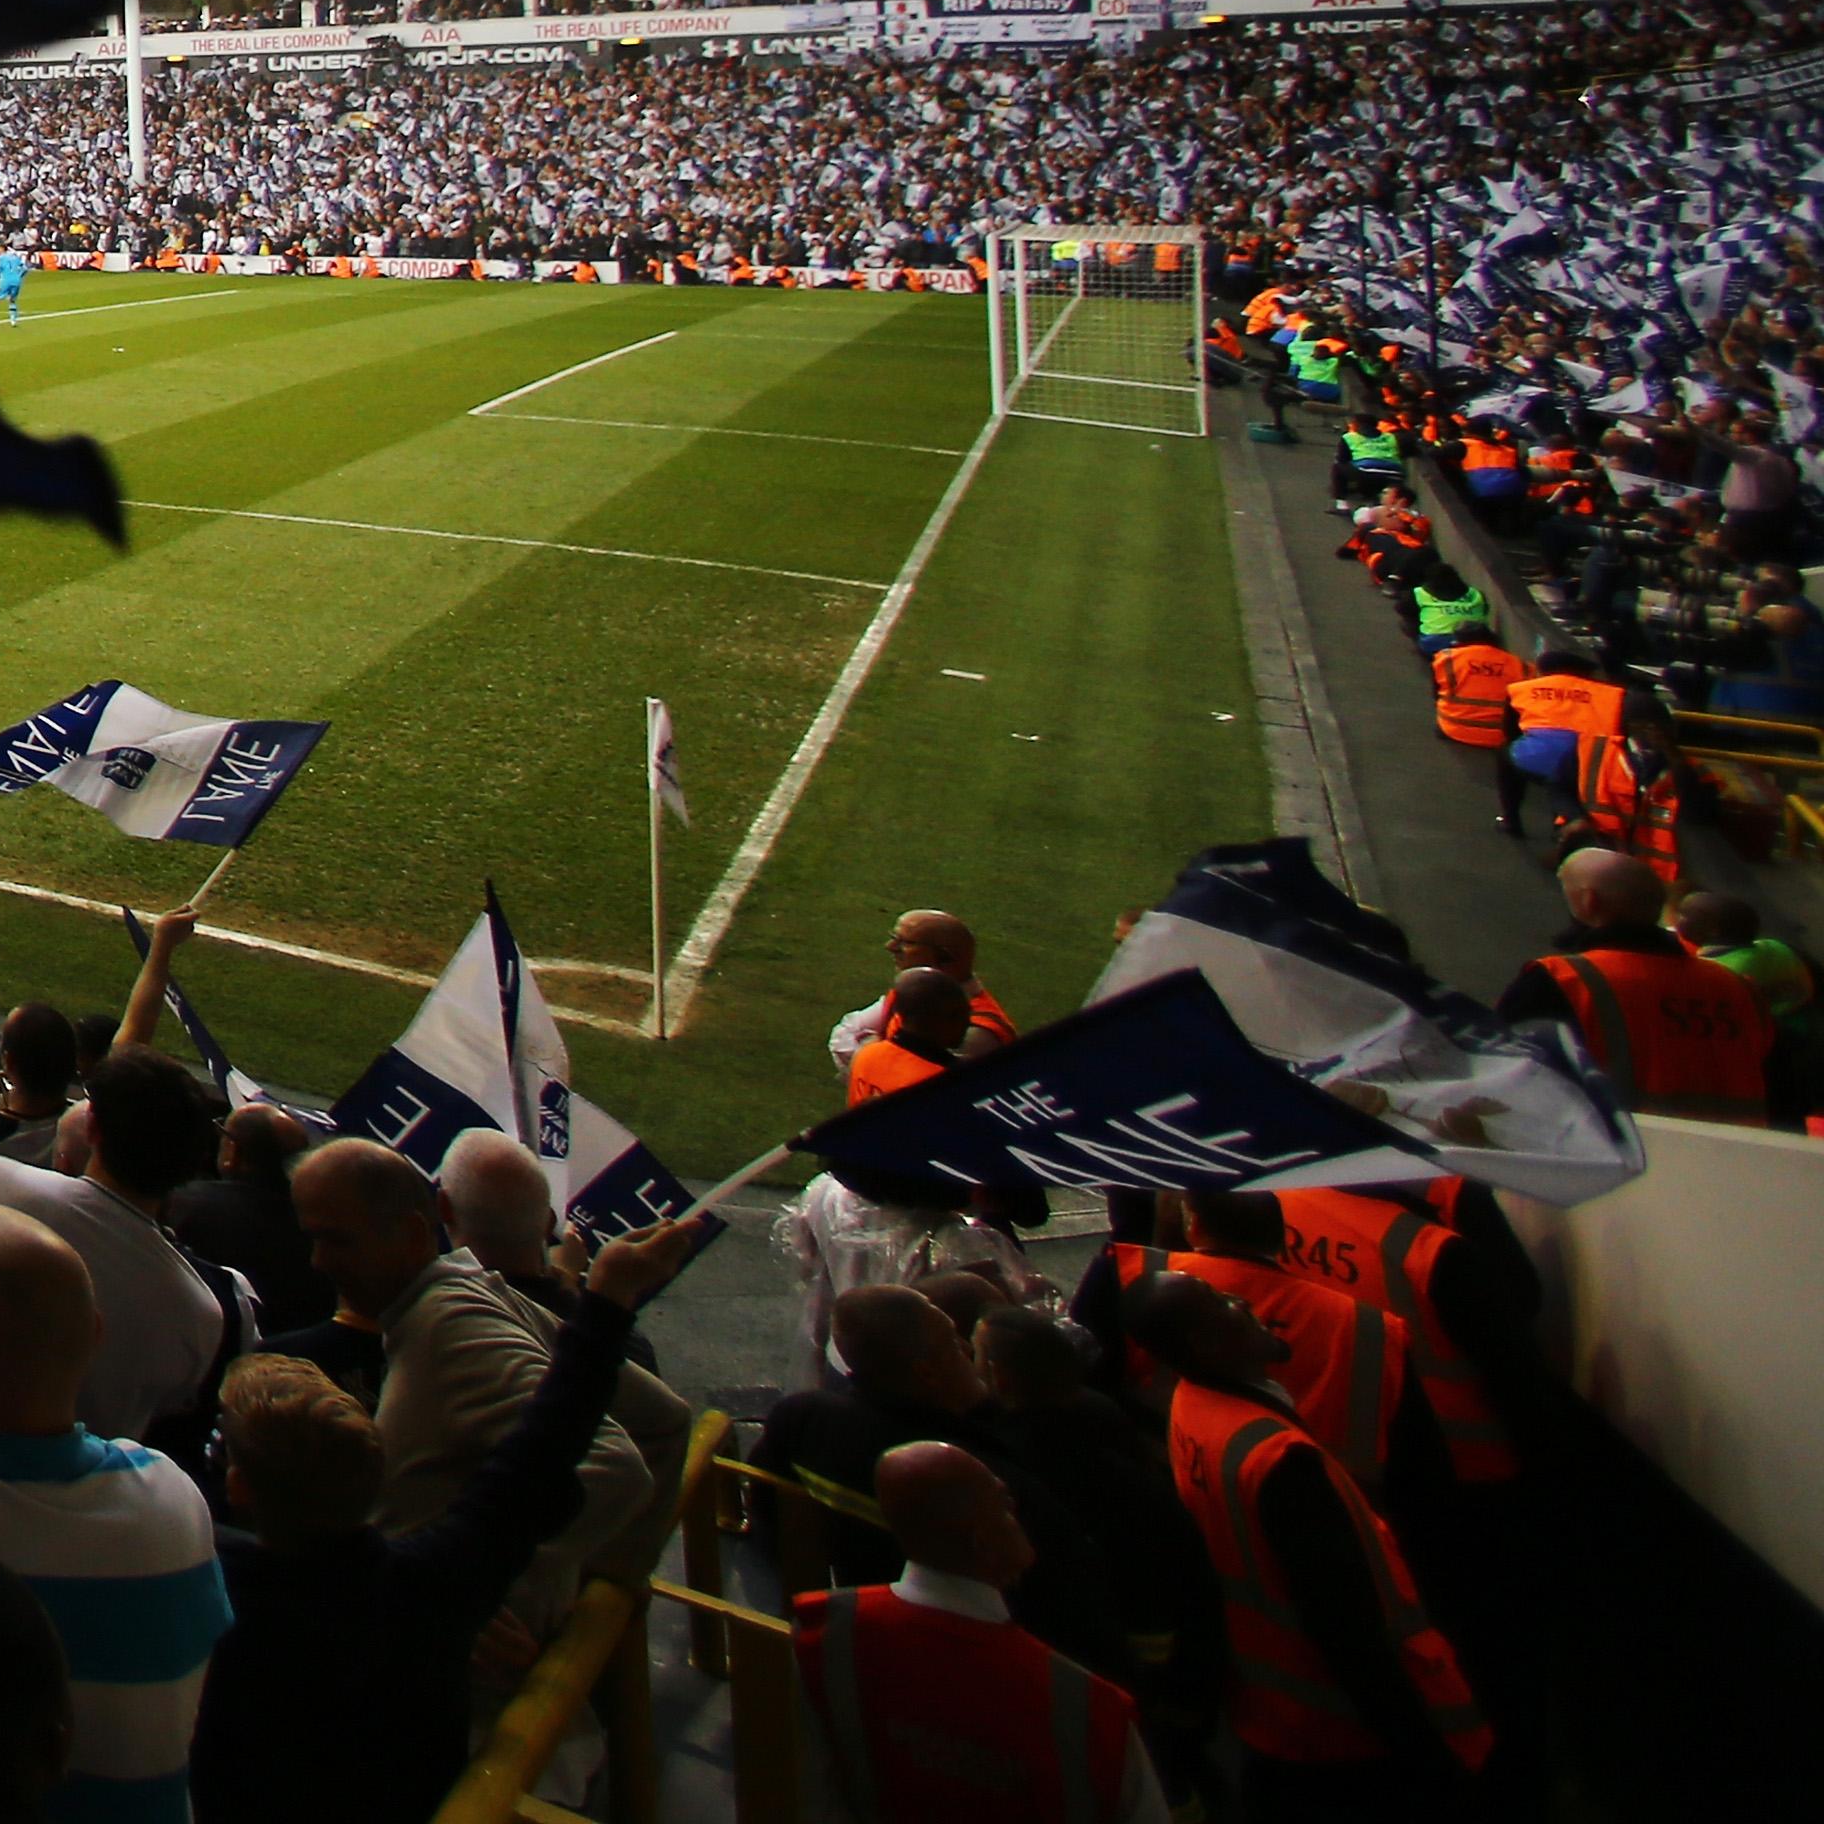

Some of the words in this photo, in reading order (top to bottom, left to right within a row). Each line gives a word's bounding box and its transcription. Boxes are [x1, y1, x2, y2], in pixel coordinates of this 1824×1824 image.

[191, 38, 216, 53] THE
[218, 37, 250, 52] REAL
[254, 35, 280, 50] LIFE
[284, 33, 353, 49] COMPANY
[421, 28, 462, 43] AIA
[535, 24, 563, 39] THE
[567, 22, 604, 38] REAL
[610, 19, 641, 35] LIFE
[647, 15, 731, 34] COMPANY
[1531, 687, 1592, 705] STEWARD
[969, 1079, 1076, 1131] THE
[927, 1091, 1321, 1198] LANE
